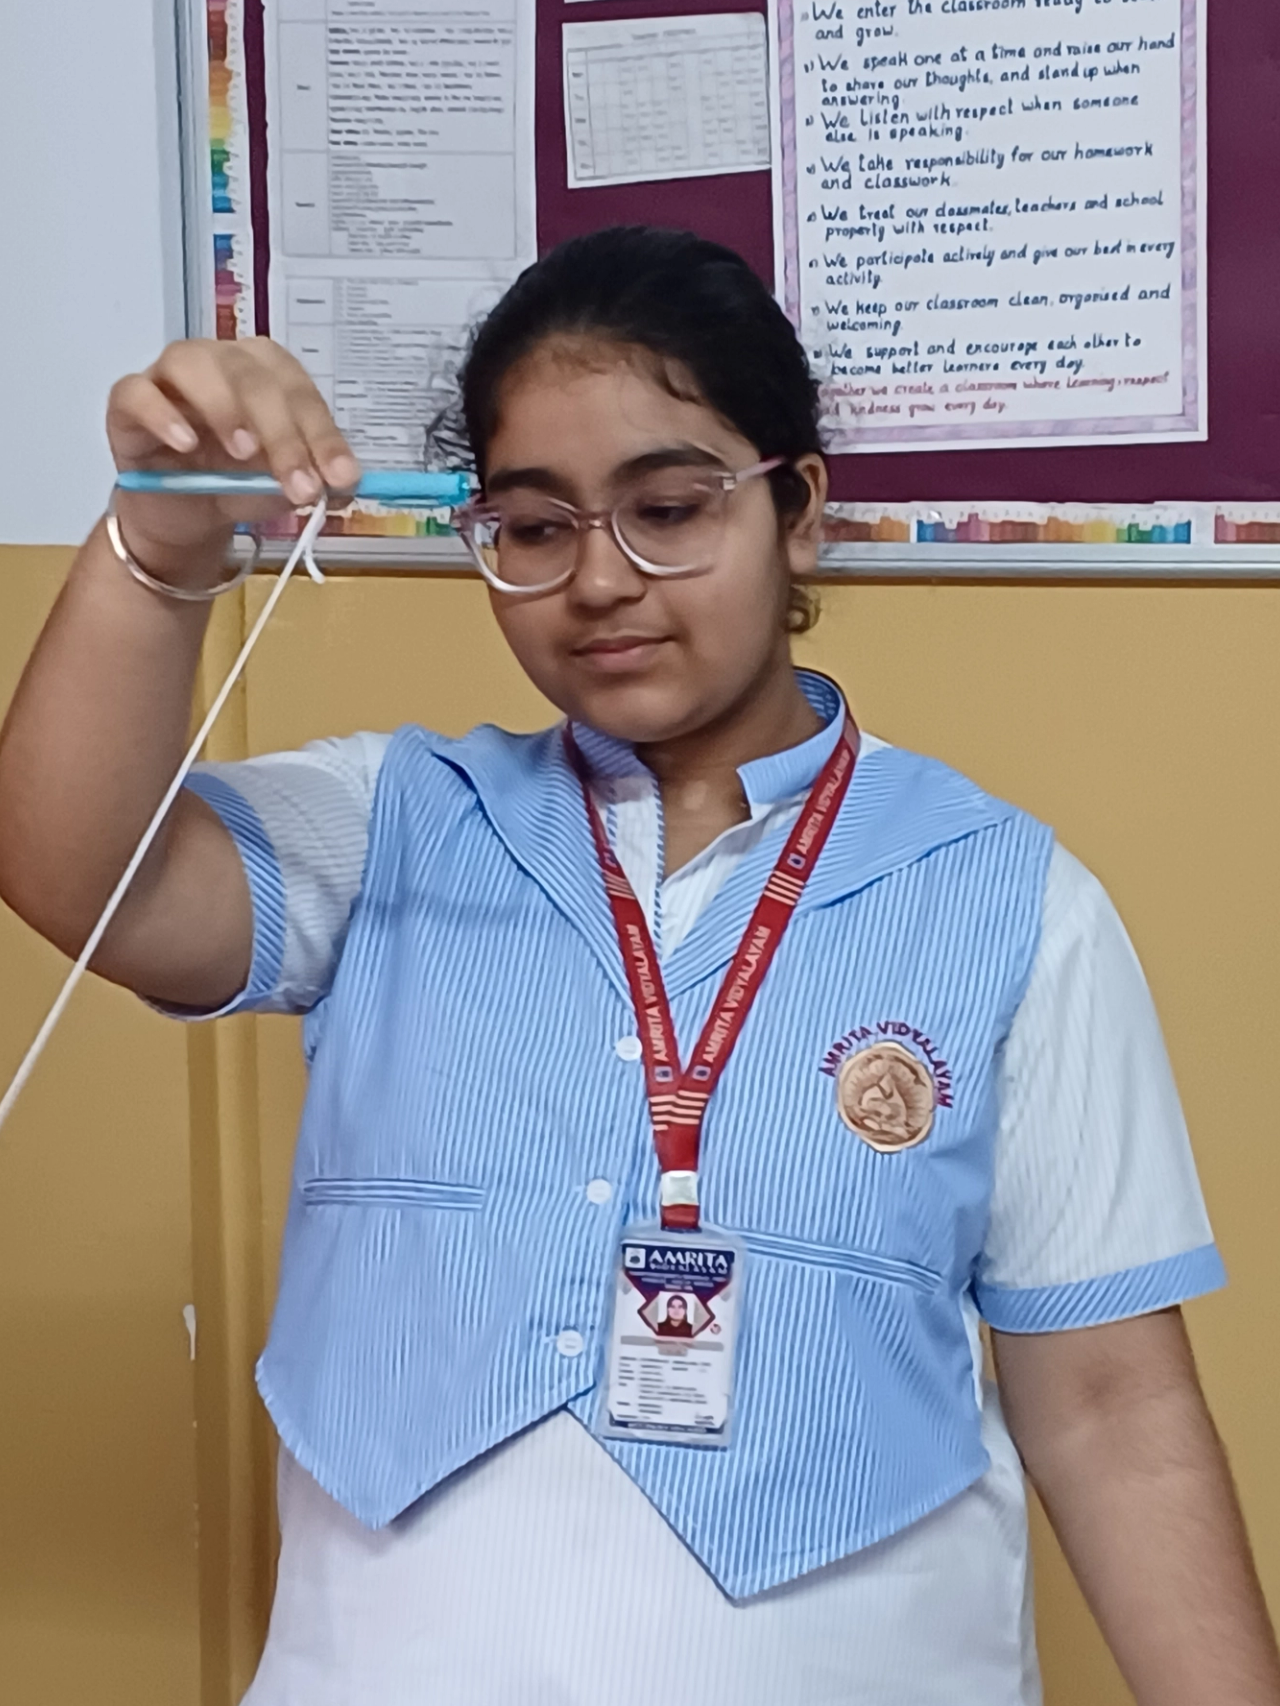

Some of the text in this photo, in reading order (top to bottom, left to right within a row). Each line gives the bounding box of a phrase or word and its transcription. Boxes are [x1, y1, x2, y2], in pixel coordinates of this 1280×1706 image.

[812, 1, 843, 22] We
[857, 0, 897, 20] enter
[816, 25, 843, 41] and
[820, 142, 1153, 174] We take responsibility for our homework
[821, 174, 852, 190] and
[703, 924, 771, 1063] AMRITA VIDYALAYAM
[647, 1005, 669, 1062] AMRITA
[818, 1020, 954, 1109] AMRITA VIDYALAYAM
[649, 1249, 728, 1269] AMRITA
